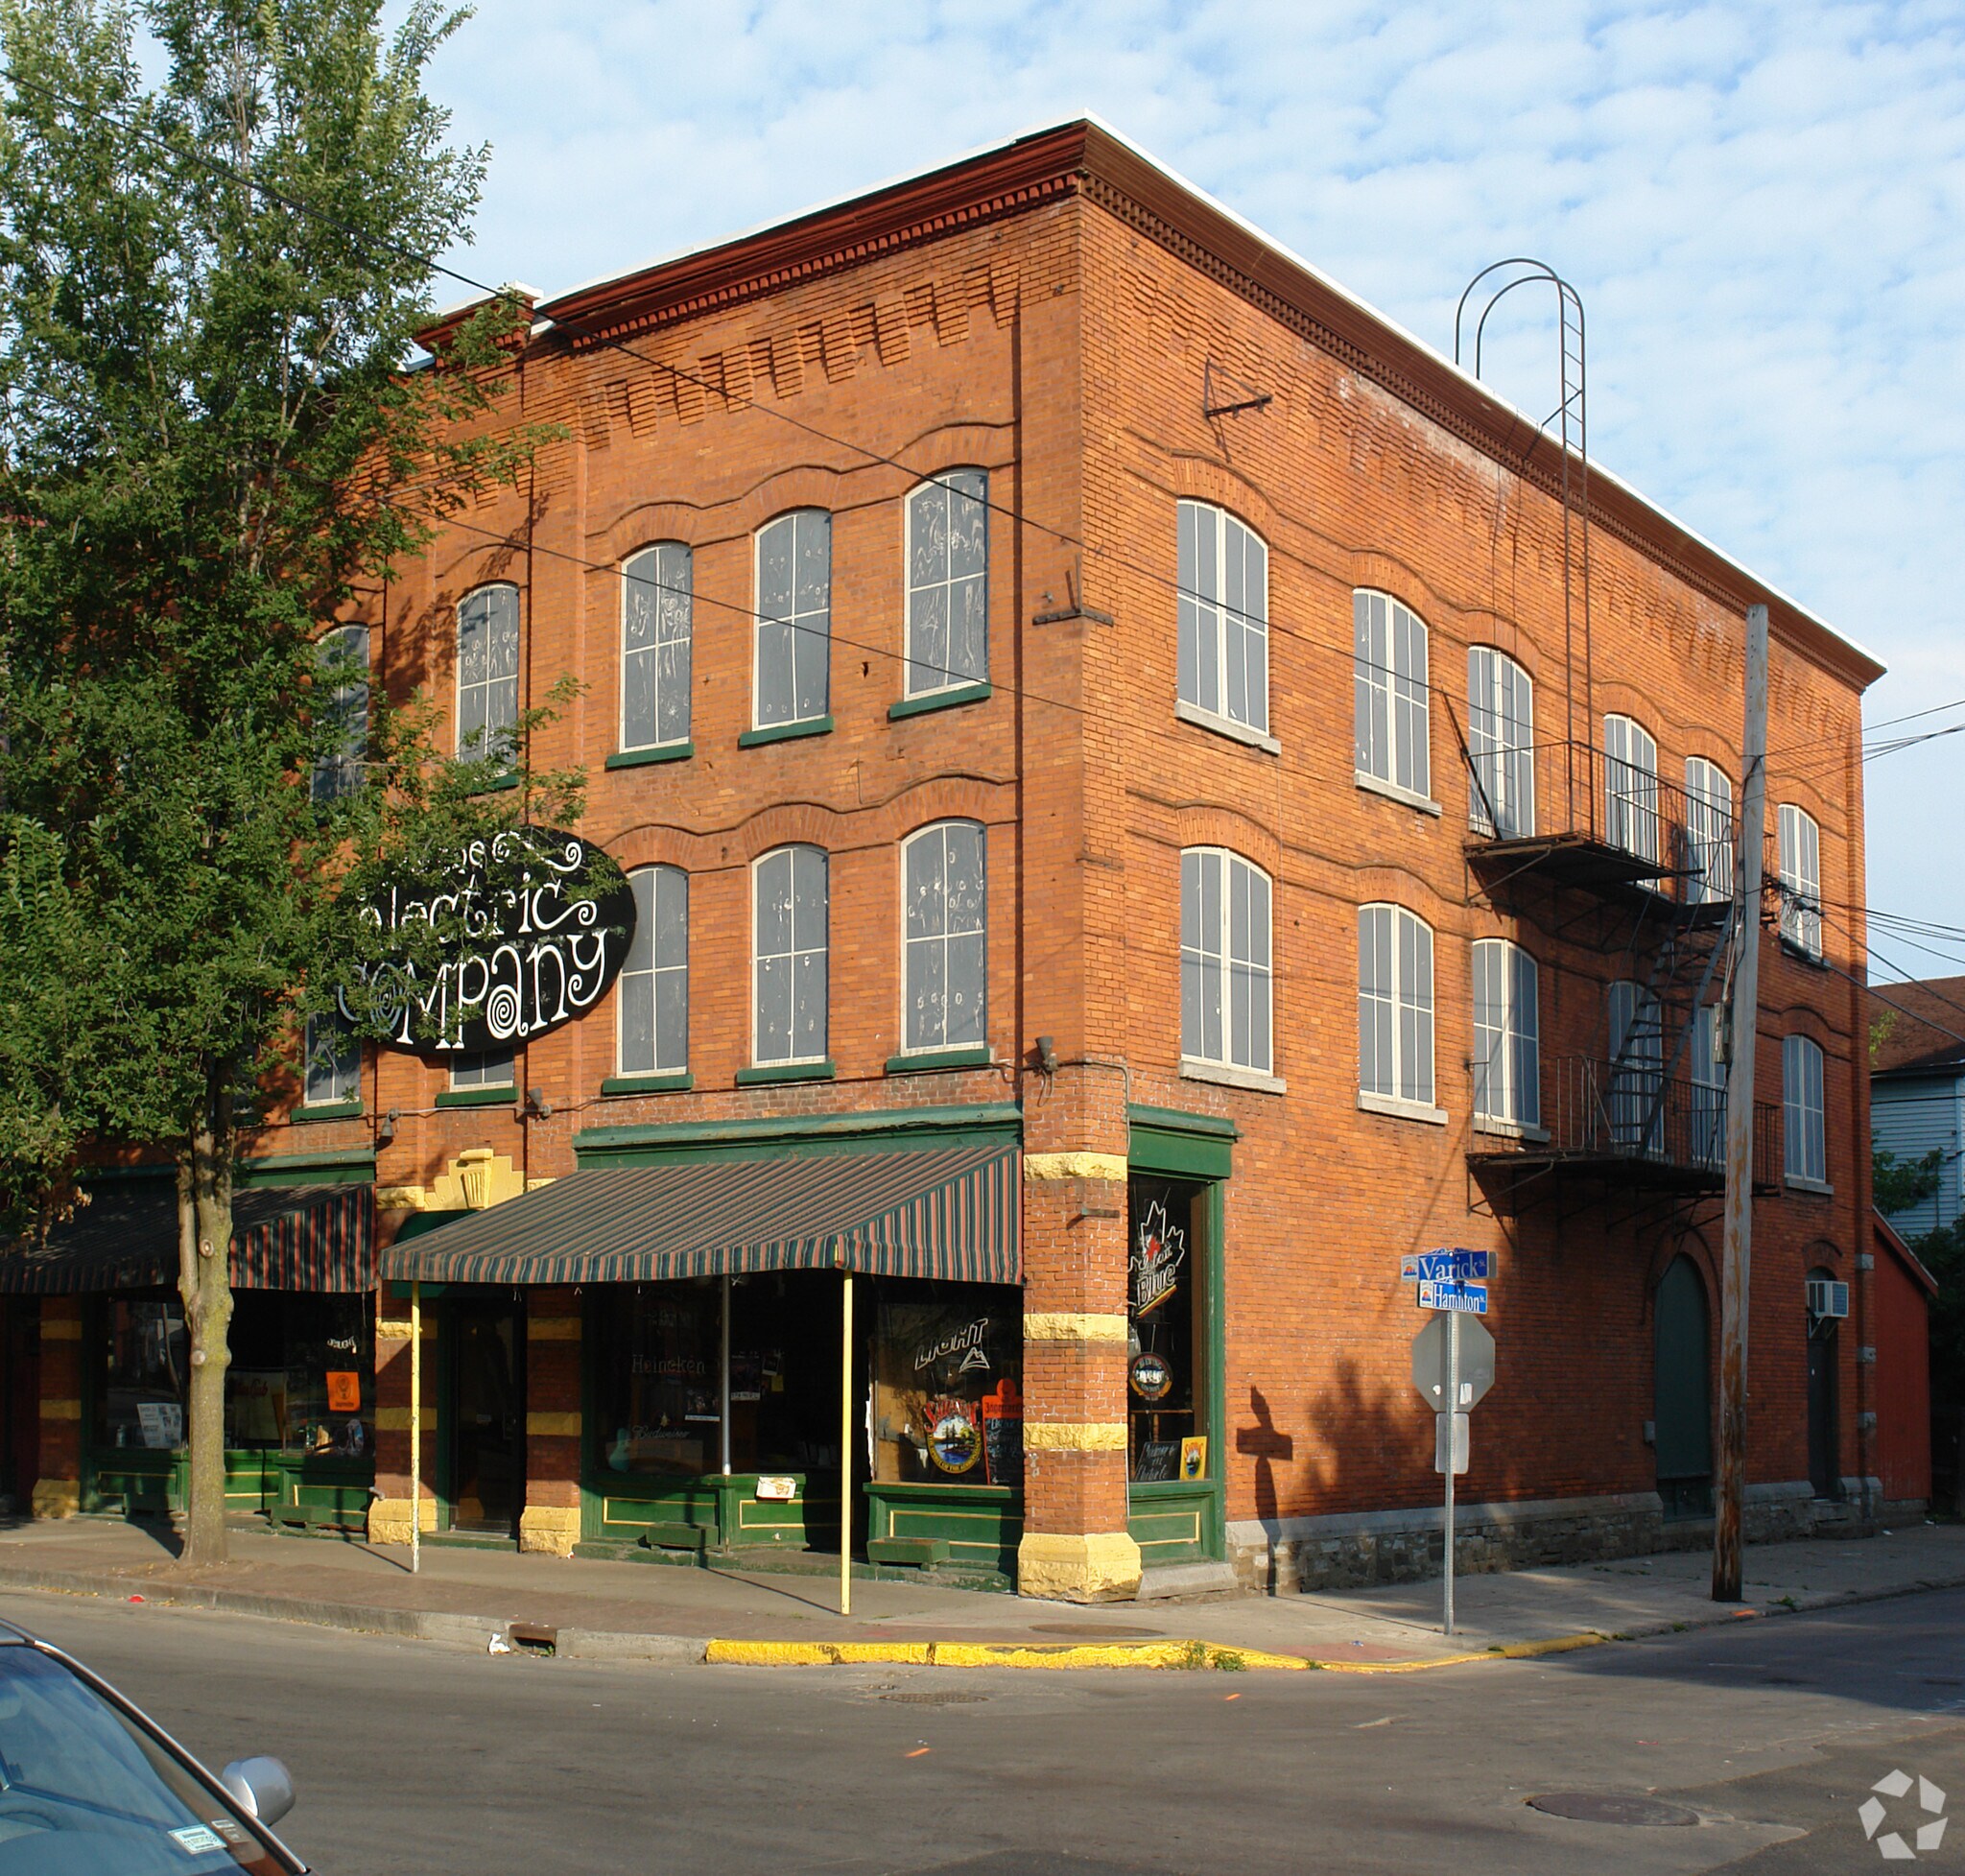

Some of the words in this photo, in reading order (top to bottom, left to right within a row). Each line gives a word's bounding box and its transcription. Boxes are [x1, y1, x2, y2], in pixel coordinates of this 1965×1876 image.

[1419, 1253, 1479, 1280] Varick
[1433, 1284, 1480, 1312] Hamilton
[914, 1318, 989, 1371] LIGHT
[631, 1354, 707, 1374] Heineken
